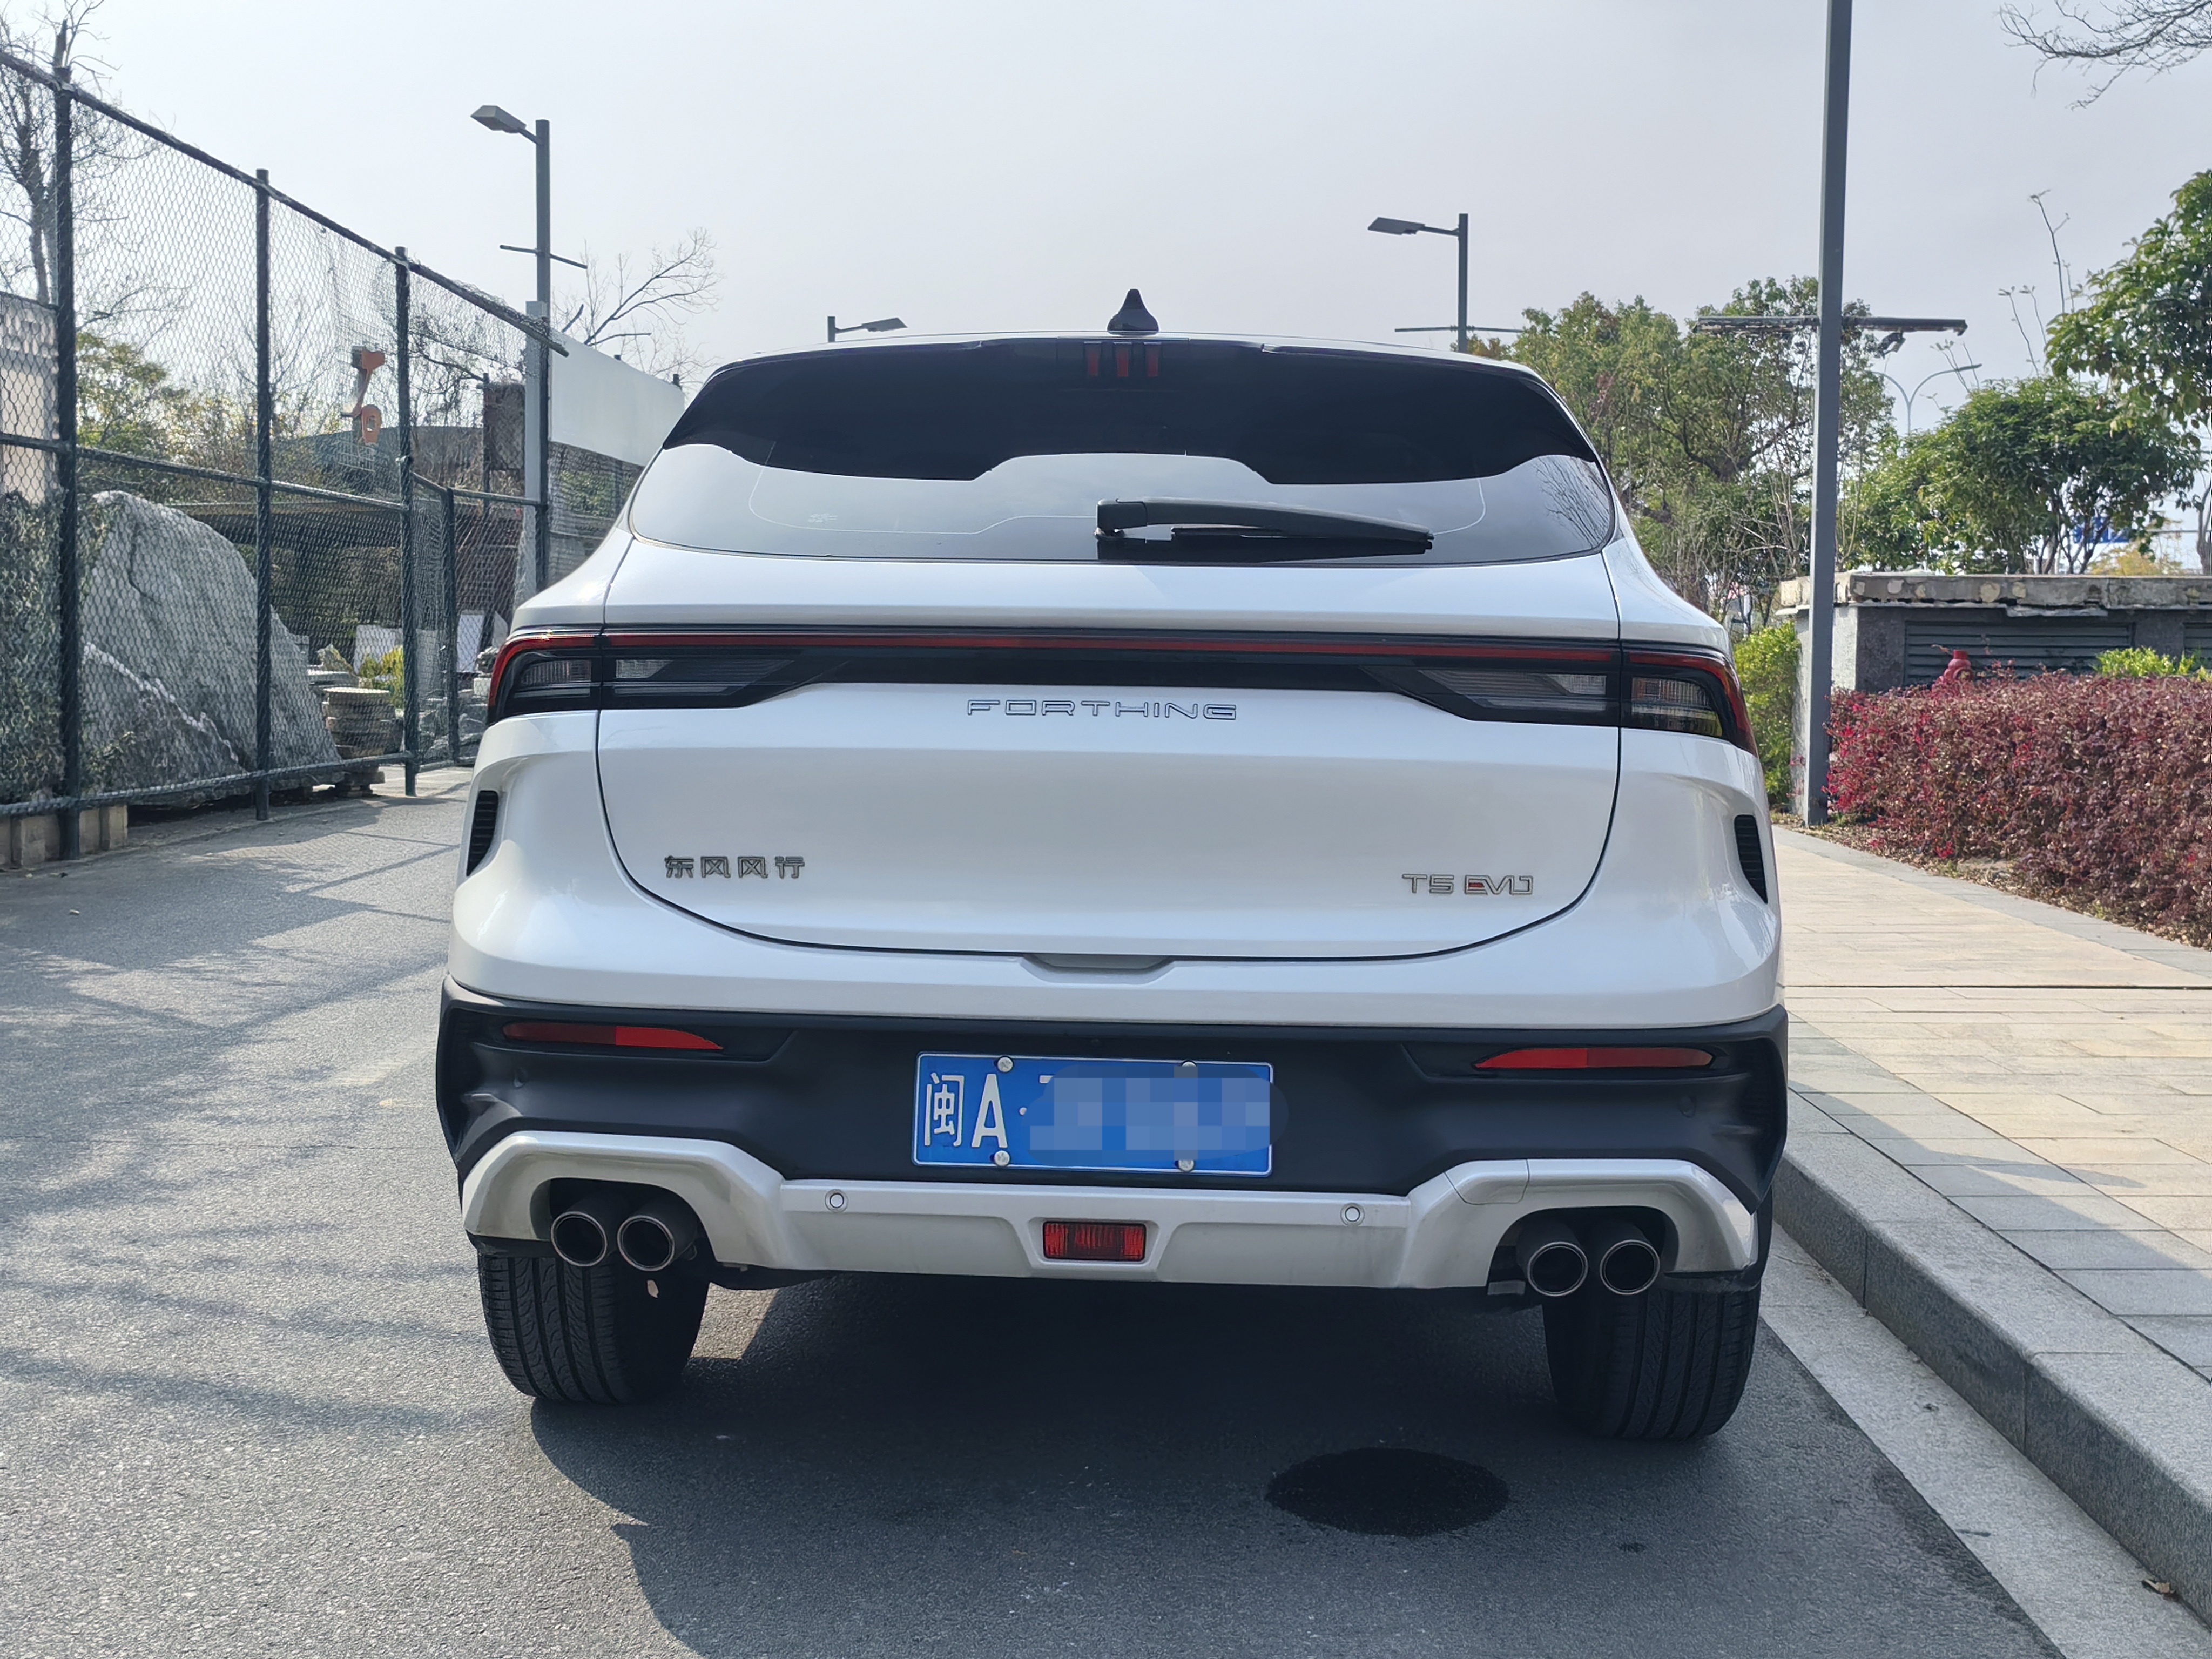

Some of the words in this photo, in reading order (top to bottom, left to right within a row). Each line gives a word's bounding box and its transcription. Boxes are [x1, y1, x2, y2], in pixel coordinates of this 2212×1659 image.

[968, 700, 1237, 720] FORTHING
[664, 855, 805, 879] 东风风行
[1402, 874, 1454, 894] T5
